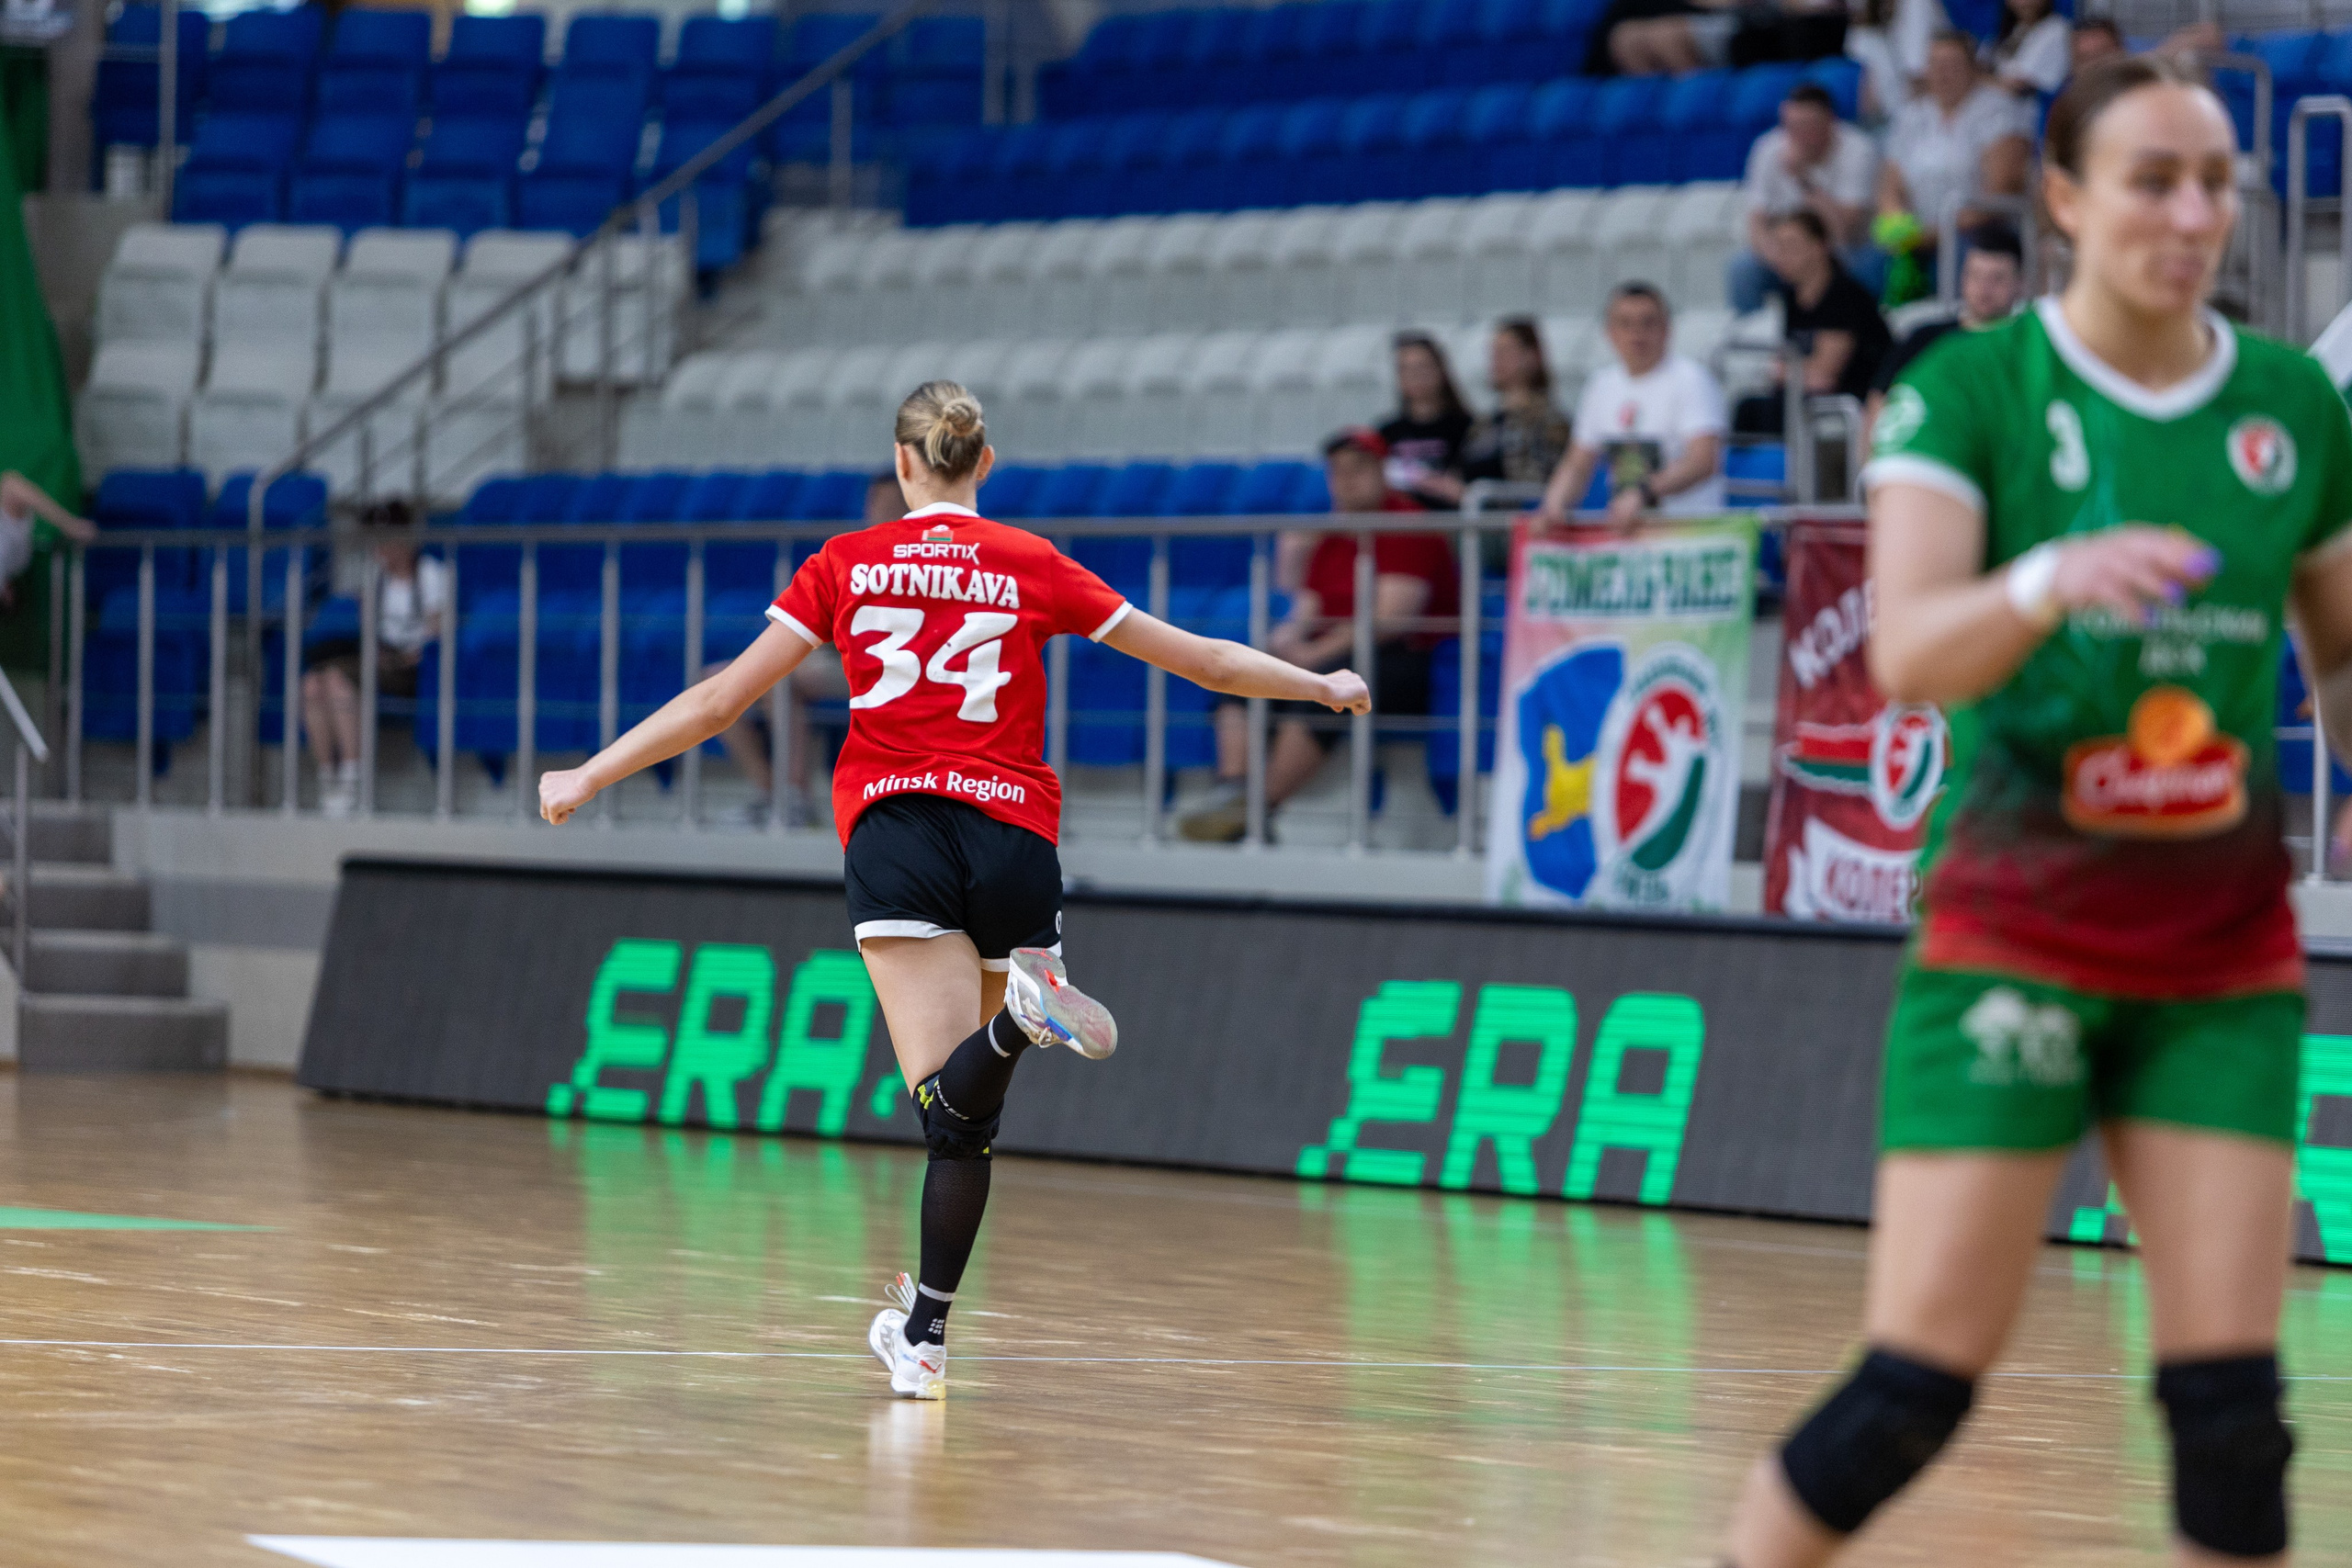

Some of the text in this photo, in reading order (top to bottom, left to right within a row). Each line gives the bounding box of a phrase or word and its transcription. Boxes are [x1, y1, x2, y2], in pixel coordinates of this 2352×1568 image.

[850, 563, 1020, 609] SOTNIKAVA
[893, 542, 980, 565] SPORTIX
[849, 604, 1018, 723] 34
[863, 770, 1026, 805] Minsk Region
[546, 937, 877, 1137] ERA
[1296, 979, 1706, 1206] ERA
